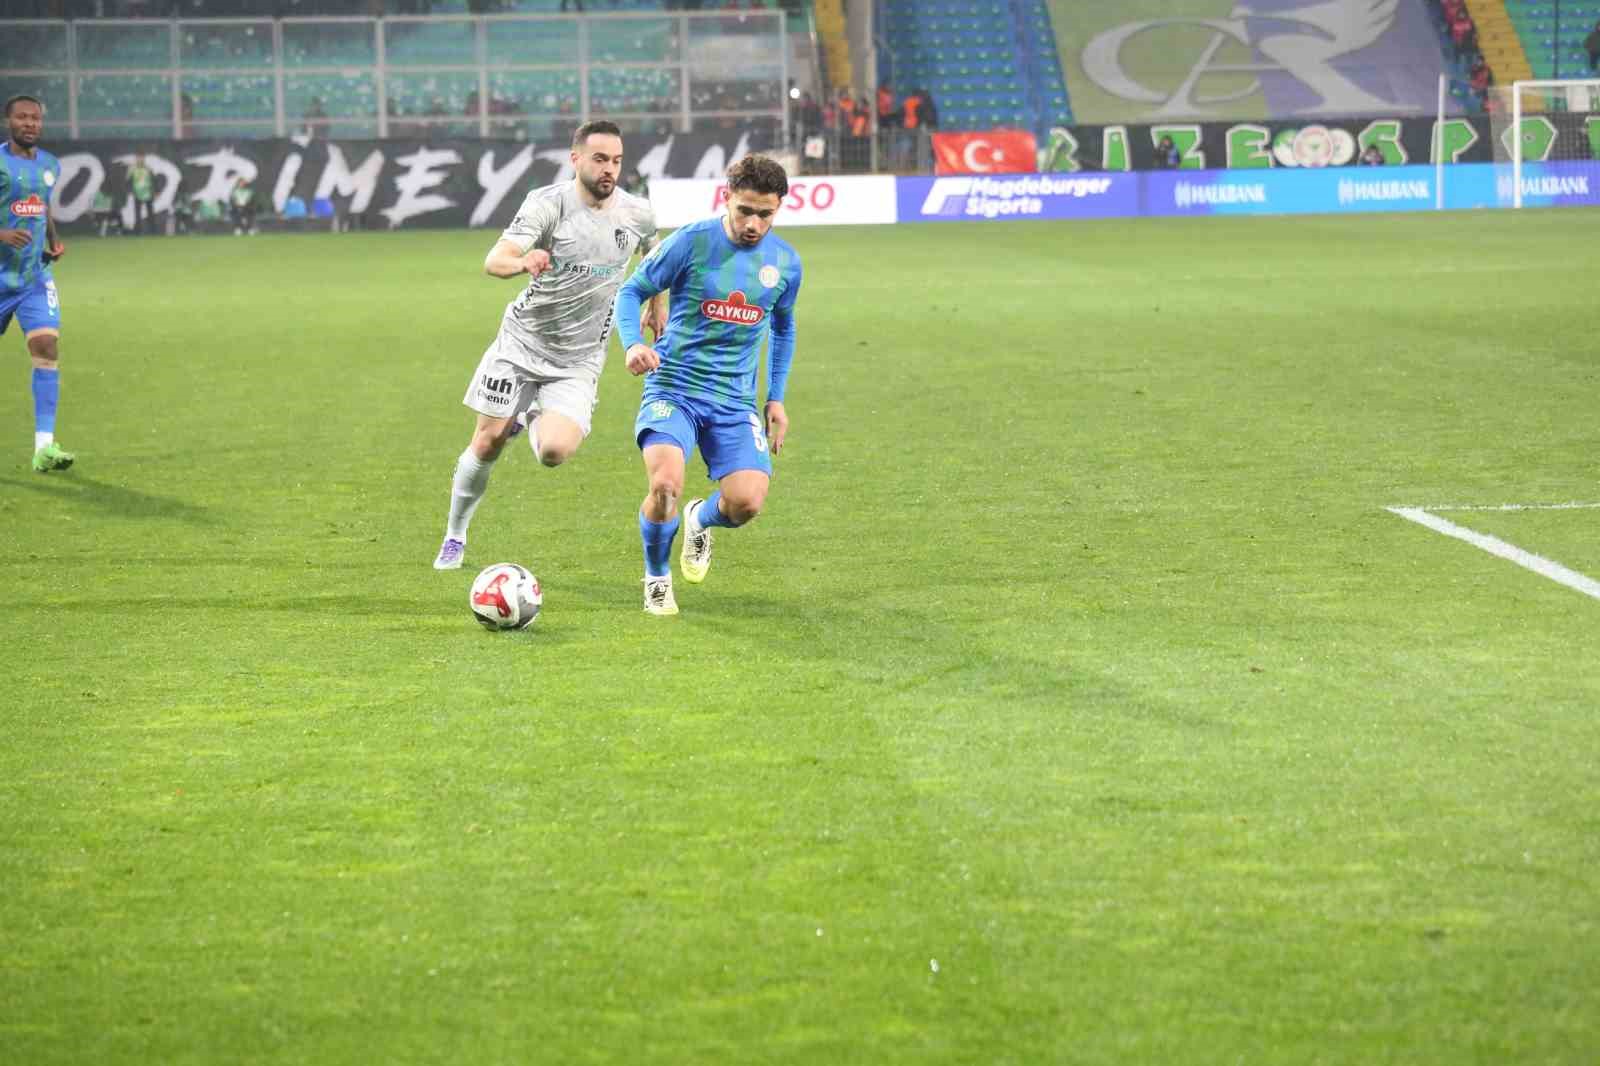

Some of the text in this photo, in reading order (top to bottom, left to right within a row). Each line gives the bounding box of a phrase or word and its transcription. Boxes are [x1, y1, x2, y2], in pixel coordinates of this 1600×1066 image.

[970, 176, 1112, 199] Magdeburger
[1191, 183, 1265, 204] HALKBANK
[1355, 180, 1430, 200] HALKBANK
[1518, 176, 1589, 196] ALKBANK
[965, 197, 1043, 218] Sigorta
